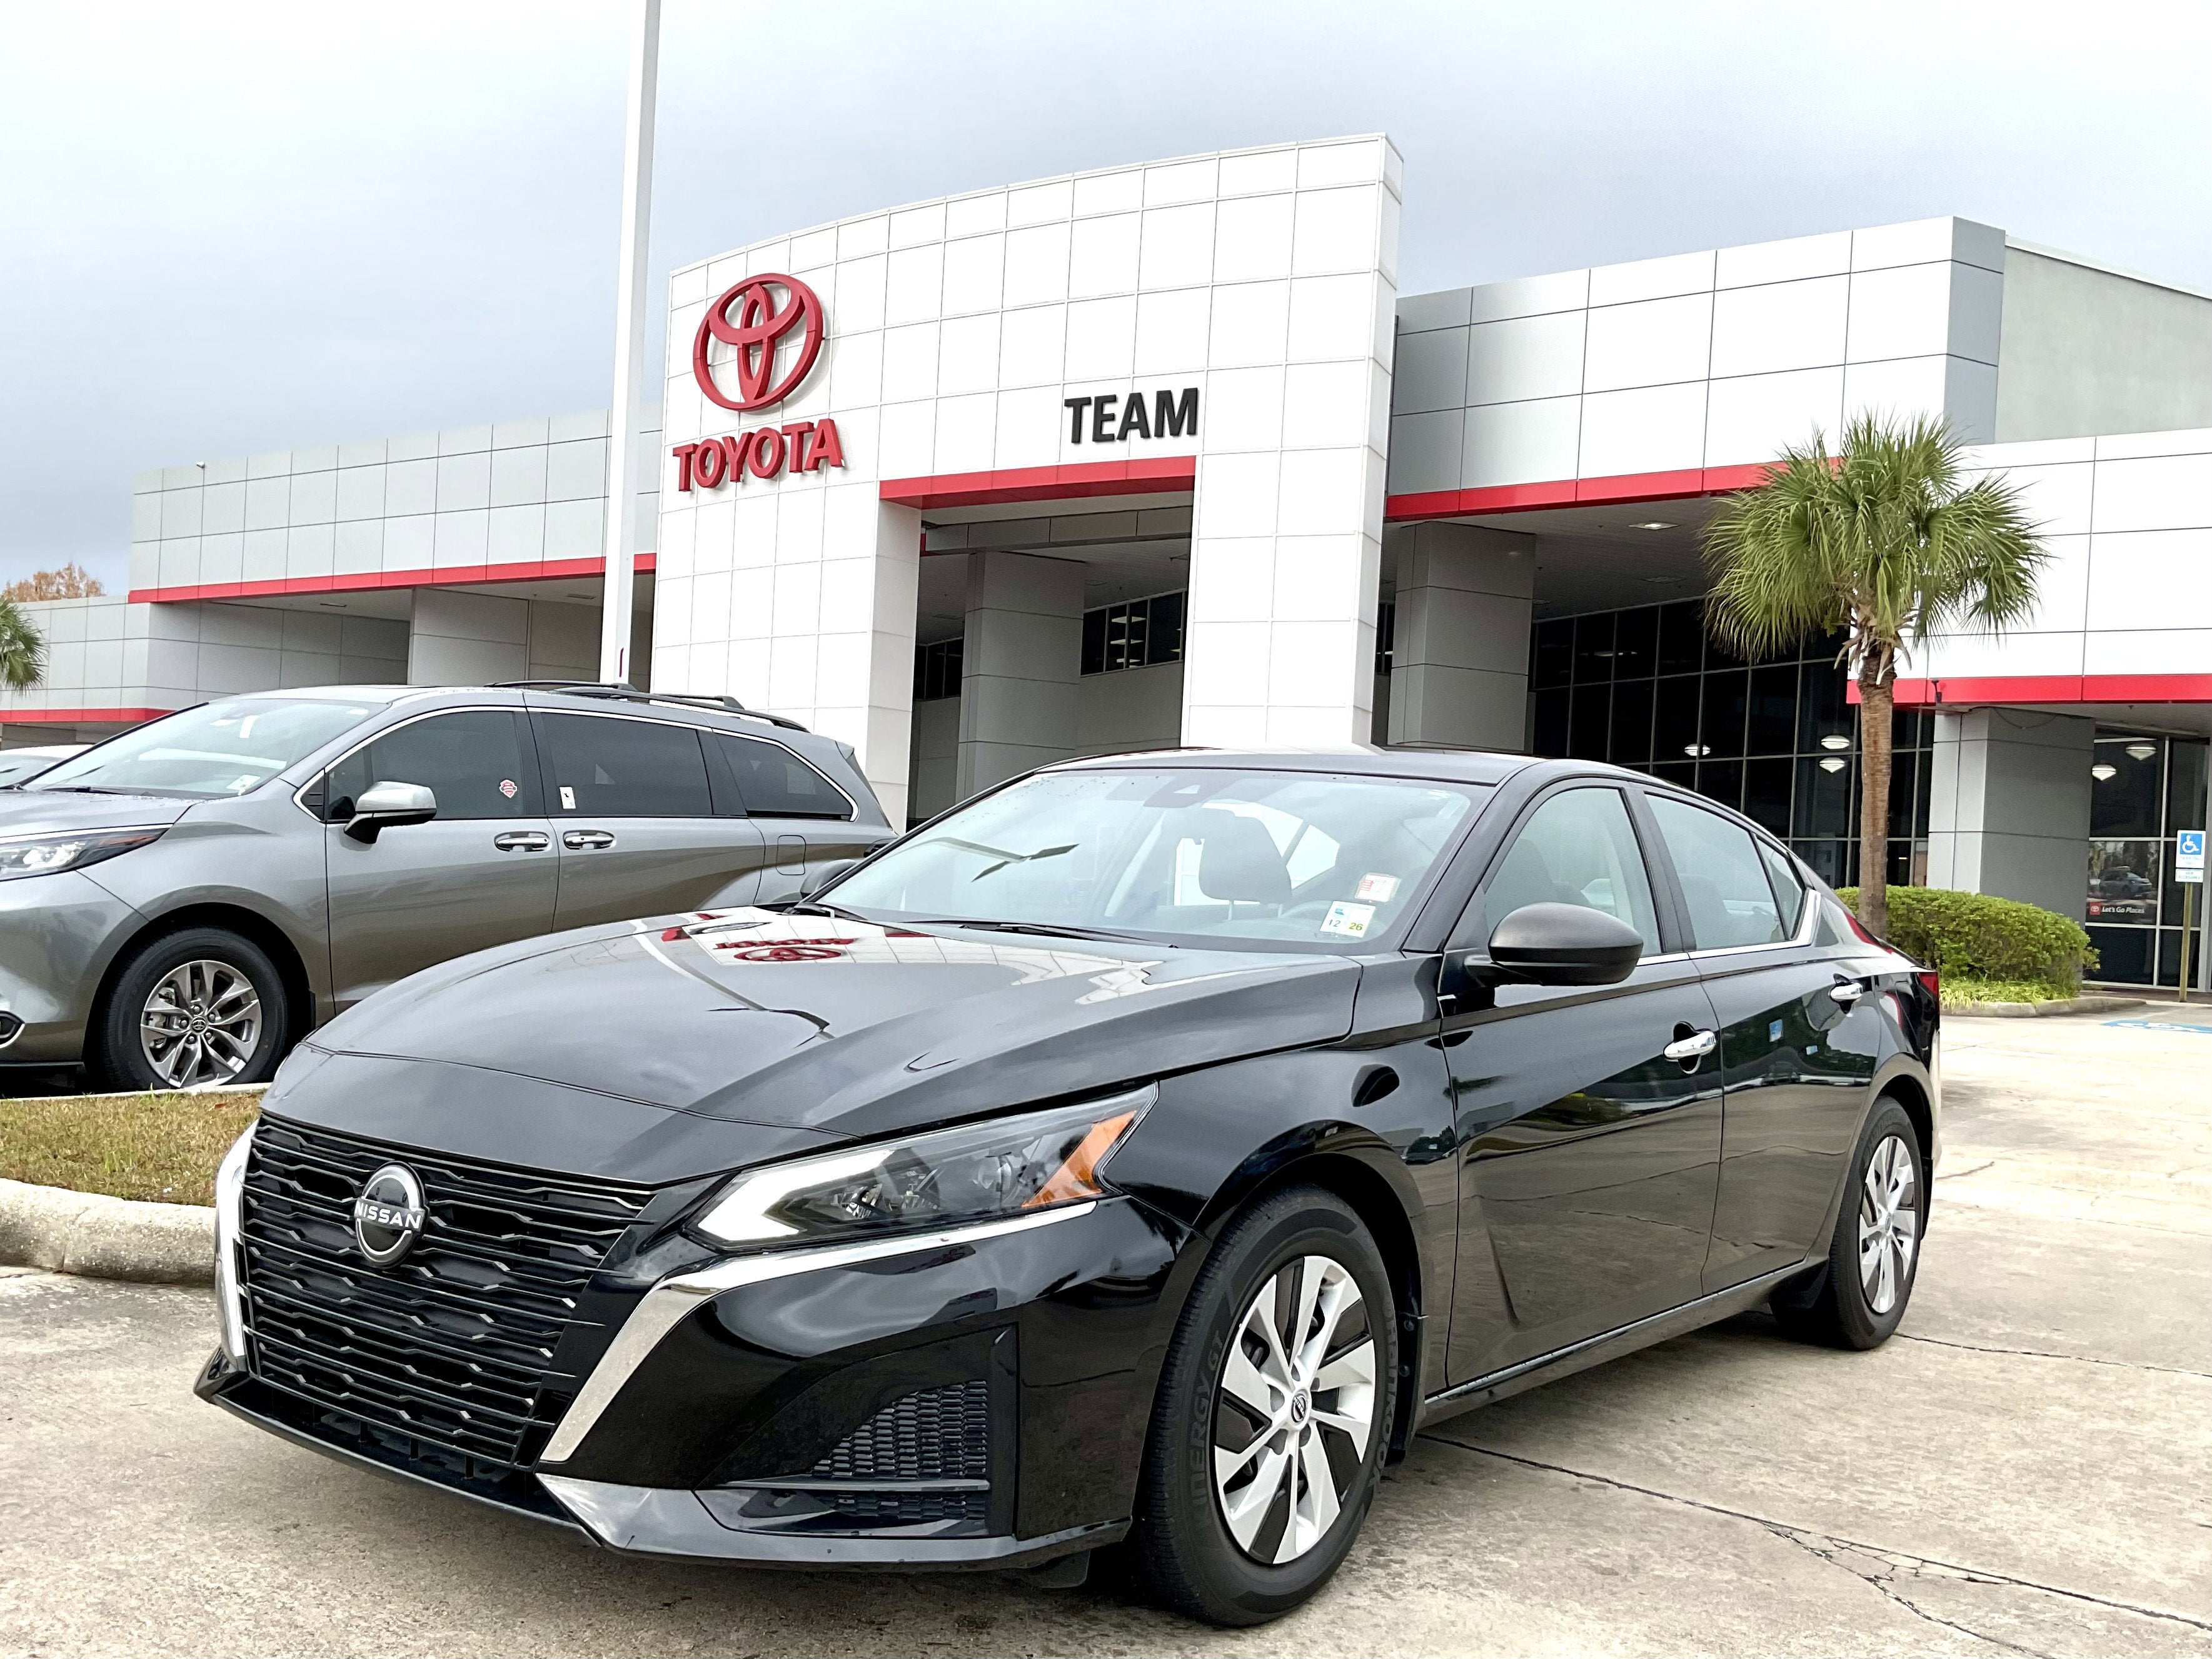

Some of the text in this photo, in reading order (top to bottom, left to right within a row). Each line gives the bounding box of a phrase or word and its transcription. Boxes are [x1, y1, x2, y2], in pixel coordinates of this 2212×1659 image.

[1063, 387, 1199, 443] TEAM
[672, 418, 844, 492] TOYOTA
[1329, 919, 1364, 931] 12 26
[354, 1200, 421, 1229] NISSAN
